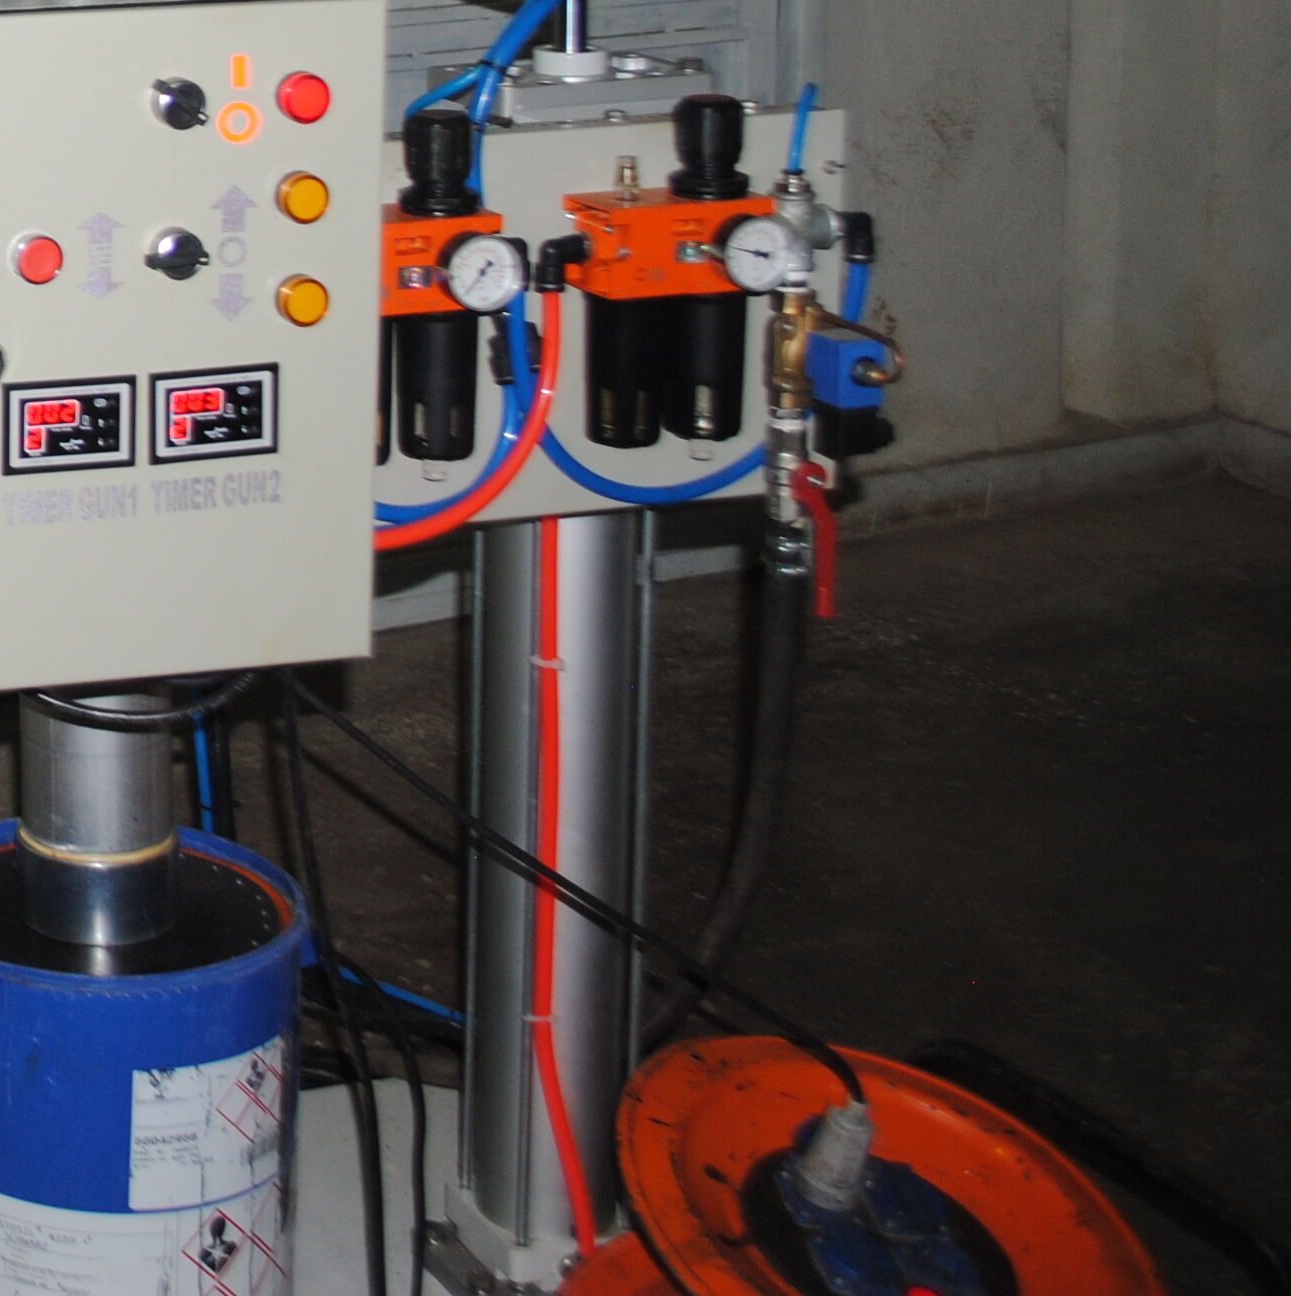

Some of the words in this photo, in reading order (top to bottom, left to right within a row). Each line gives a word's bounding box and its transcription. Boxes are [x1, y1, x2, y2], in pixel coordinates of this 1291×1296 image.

[79, 484, 138, 521] GUN1
[150, 477, 216, 513] TIMER
[222, 470, 282, 507] GUN2
